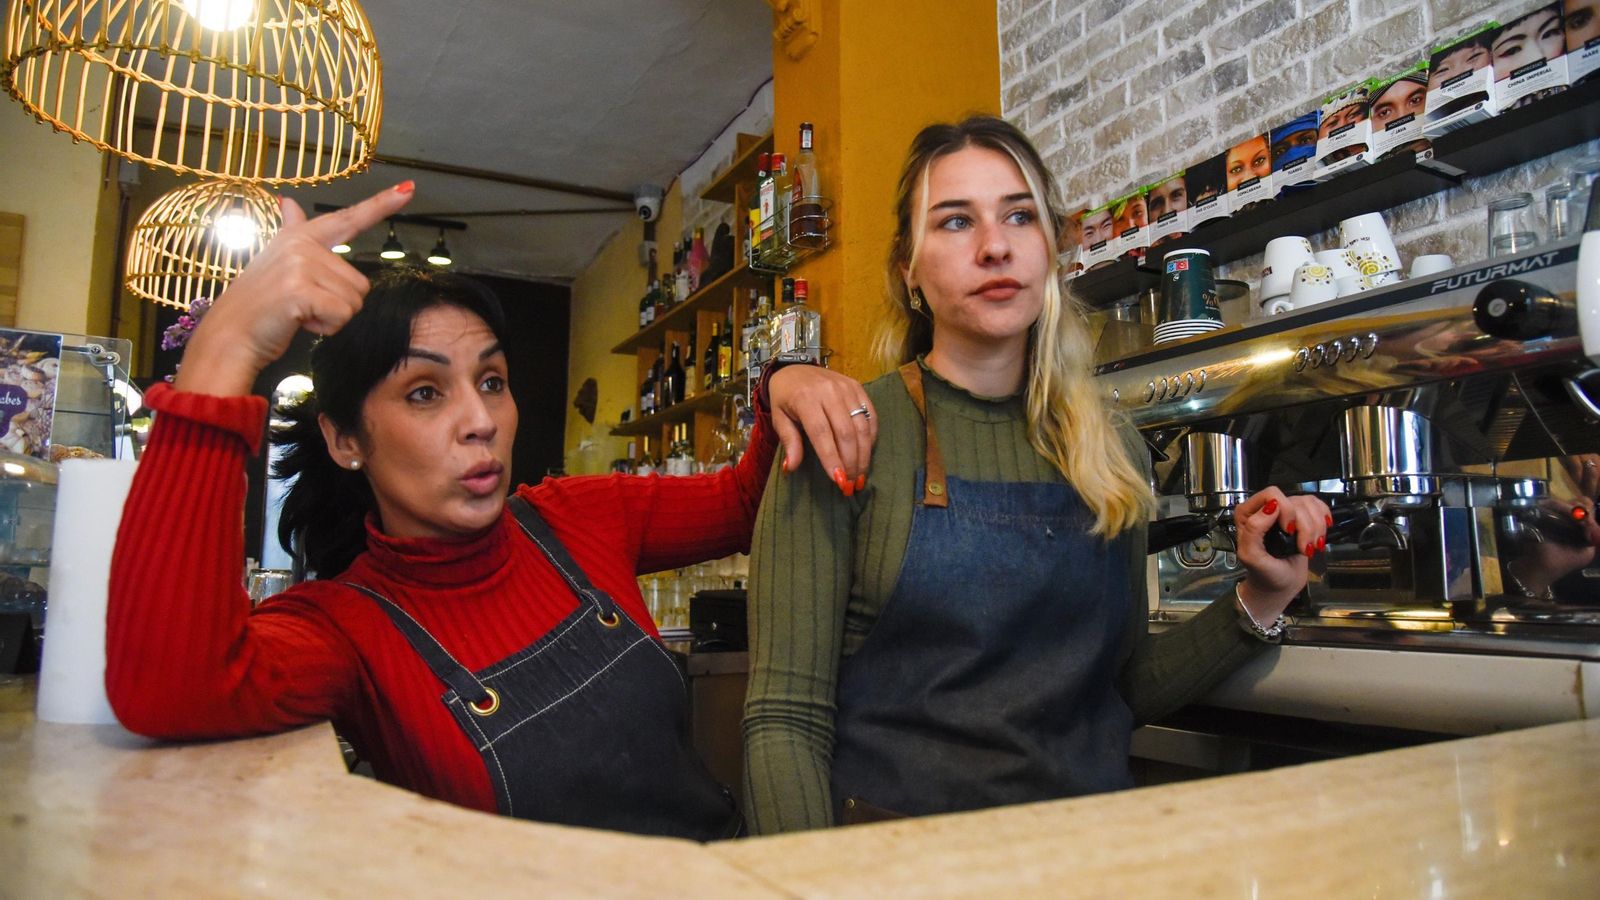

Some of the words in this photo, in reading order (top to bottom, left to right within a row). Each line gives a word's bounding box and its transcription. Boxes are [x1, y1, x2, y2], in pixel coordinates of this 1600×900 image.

[1508, 78, 1525, 88] CHINA
[1526, 67, 1552, 81] IMPERIAL
[1395, 126, 1407, 135] JAVA
[1431, 251, 1559, 294] FUTURMAT
